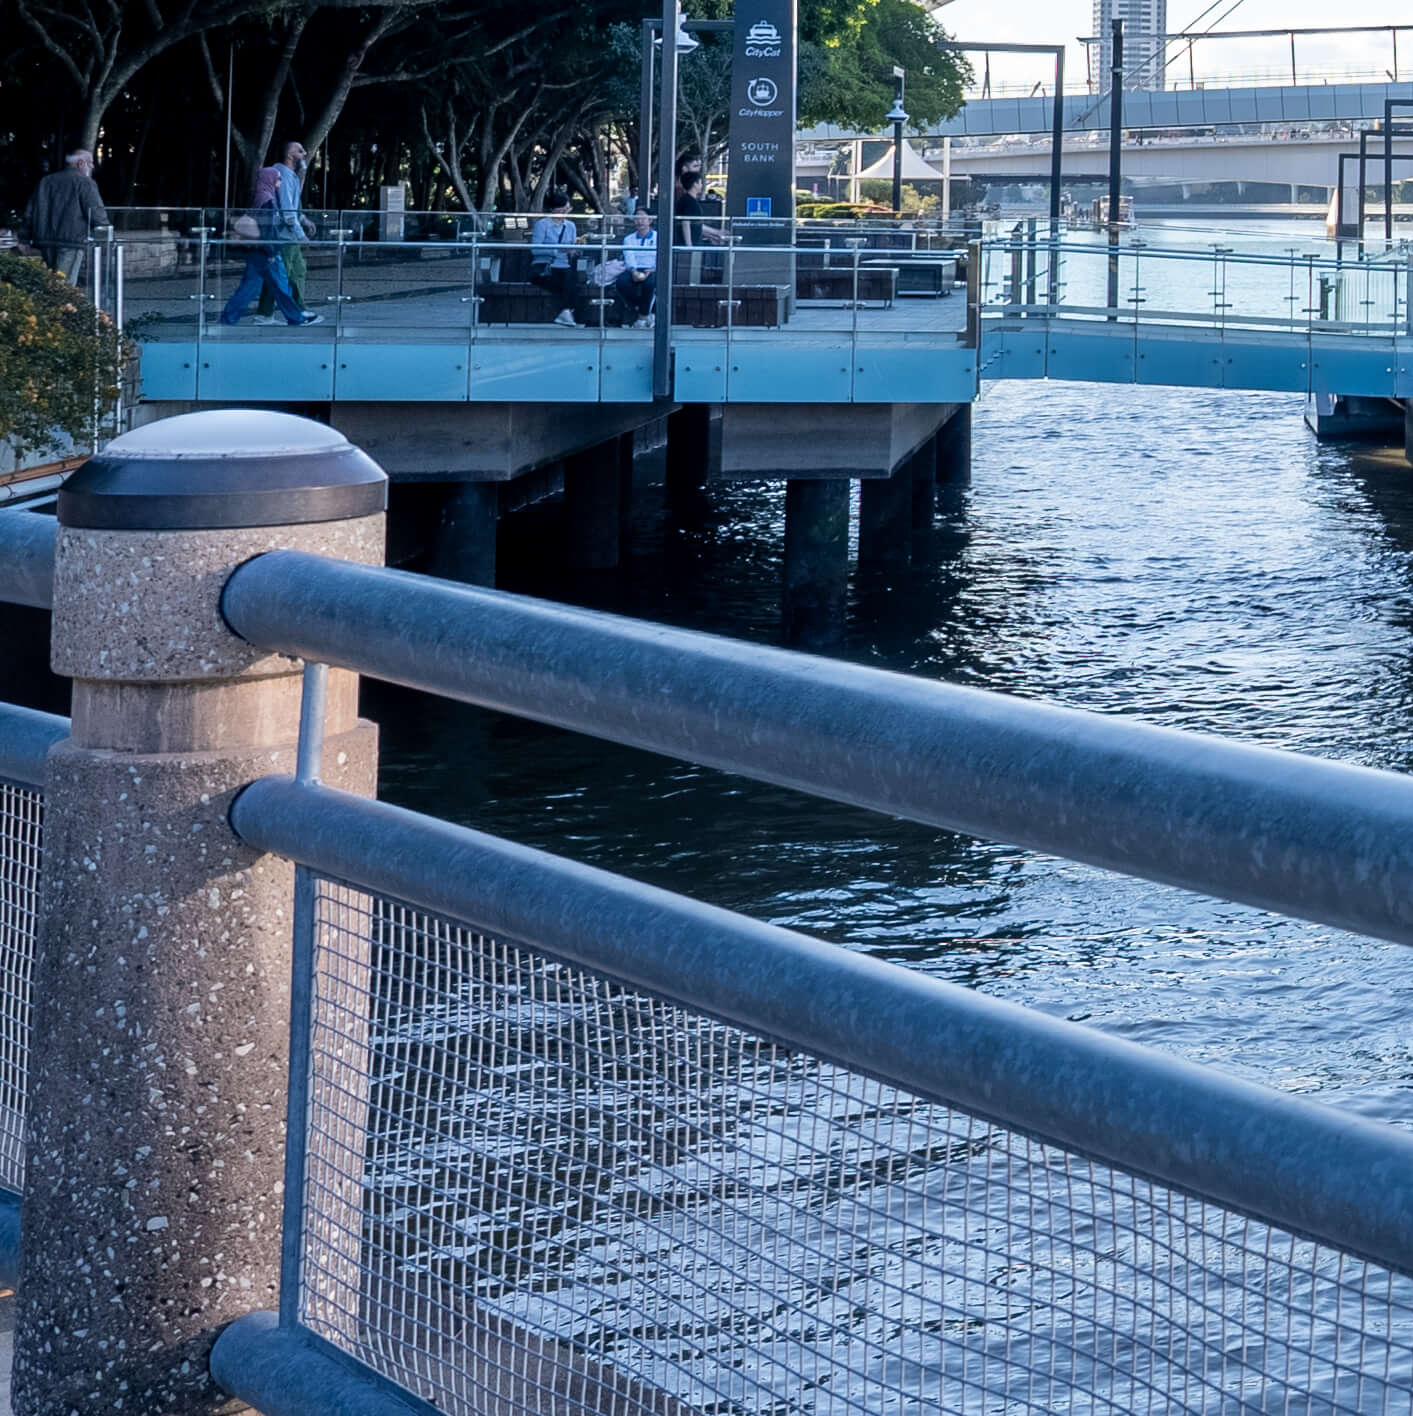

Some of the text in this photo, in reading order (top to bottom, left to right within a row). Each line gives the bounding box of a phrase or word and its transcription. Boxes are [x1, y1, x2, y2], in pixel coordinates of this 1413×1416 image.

[745, 47, 781, 58] CityCat
[739, 108, 784, 117] CityHopper
[741, 143, 779, 151] SOUTH
[744, 154, 776, 162] BANK
